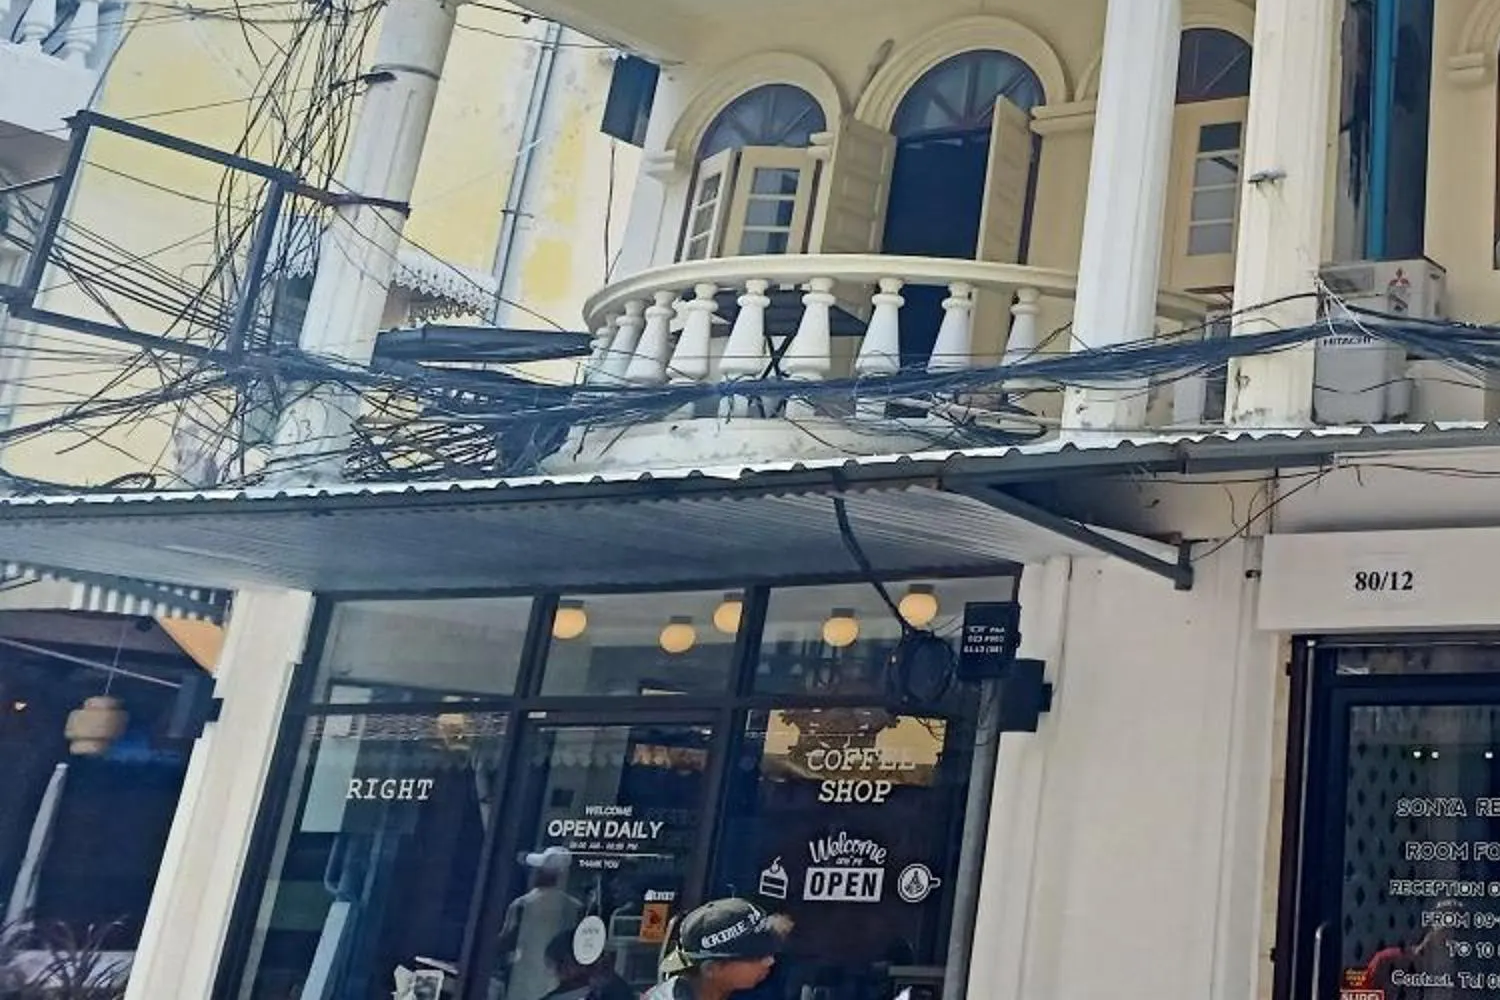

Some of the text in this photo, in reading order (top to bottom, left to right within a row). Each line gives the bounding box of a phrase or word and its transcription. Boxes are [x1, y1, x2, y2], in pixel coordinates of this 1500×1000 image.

[1355, 570, 1413, 591] 80/12
[345, 778, 433, 800] RIGHT
[818, 779, 891, 802] SHOP
[585, 805, 633, 816] WELCOME
[1396, 798, 1467, 817] SONYA
[548, 820, 664, 839] OPEN DAILY
[809, 831, 887, 865] Welcome
[1405, 841, 1468, 860] ROOM
[809, 871, 879, 897] OPEN
[1389, 879, 1485, 897] RECEPTION
[1421, 911, 1470, 928] FROM
[1446, 940, 1472, 958] TO
